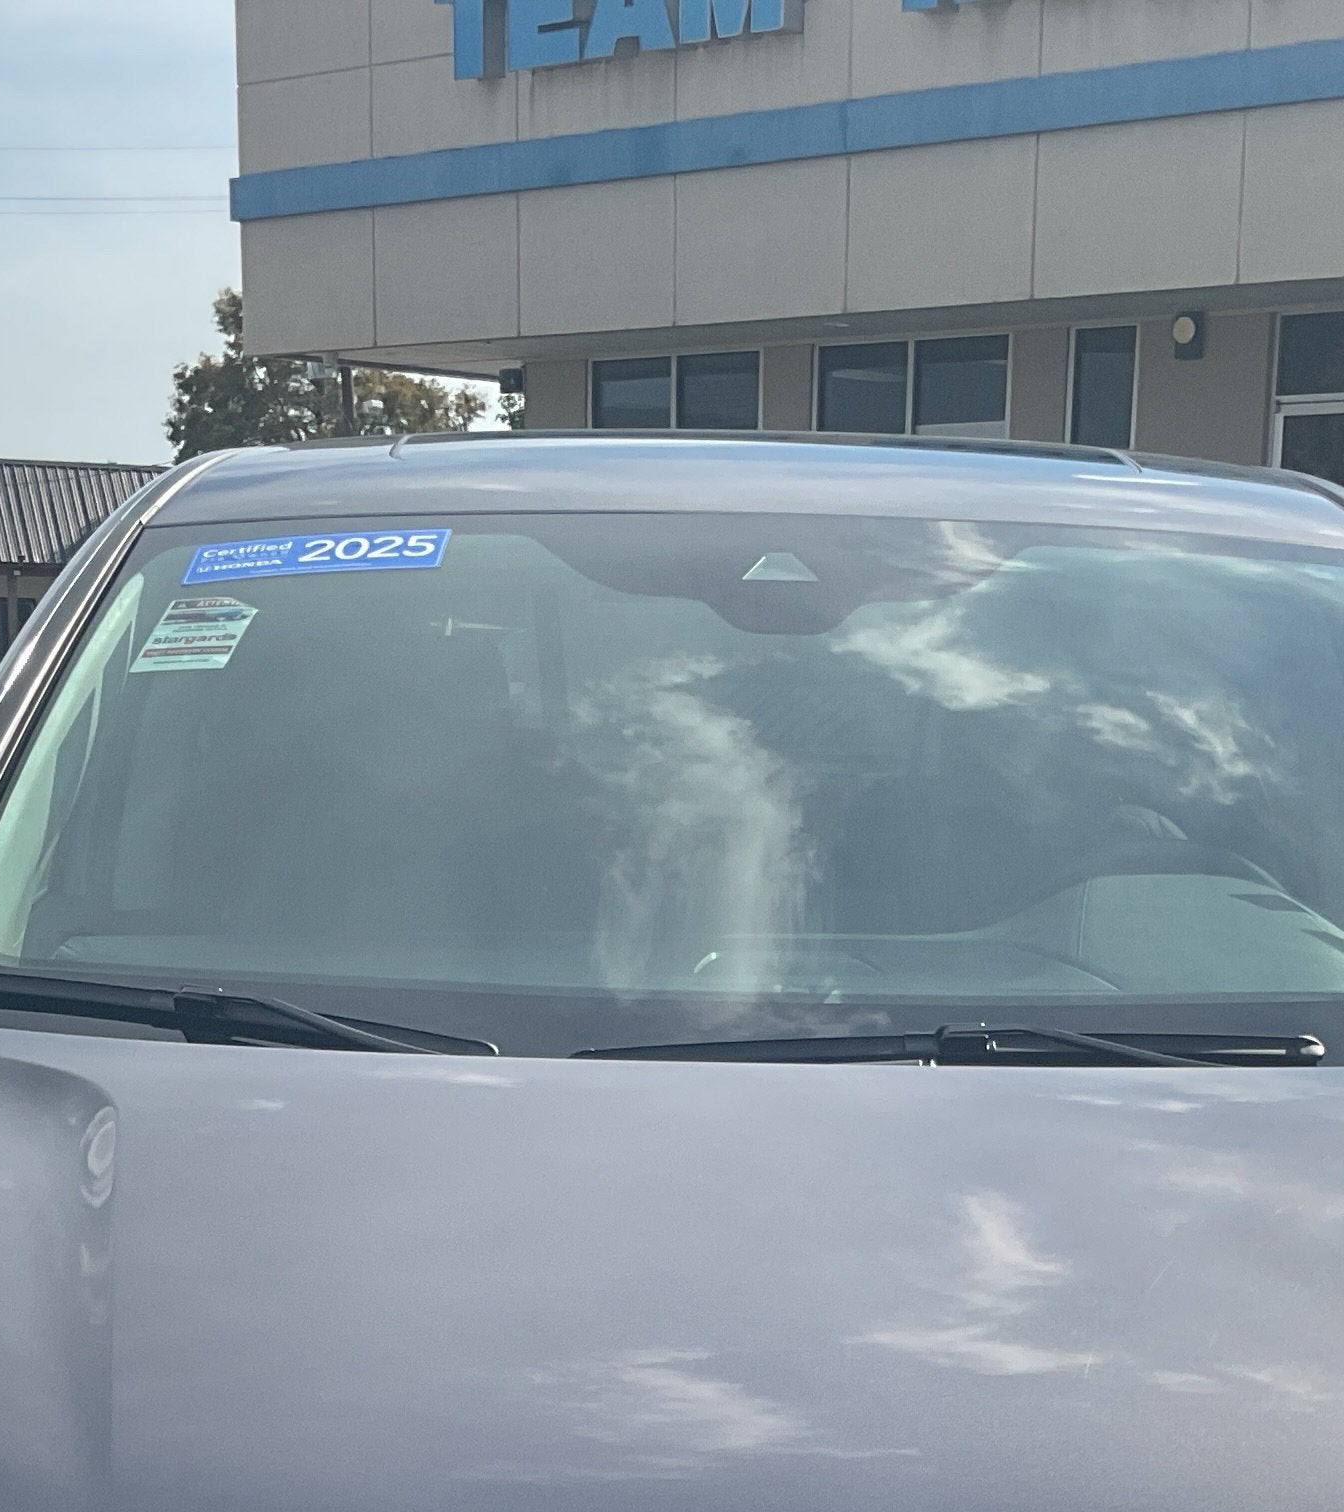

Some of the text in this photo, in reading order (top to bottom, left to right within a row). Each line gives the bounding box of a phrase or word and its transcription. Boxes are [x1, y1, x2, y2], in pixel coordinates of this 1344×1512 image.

[202, 541, 293, 558] Certified
[297, 535, 438, 562] 2025
[213, 559, 283, 571] HONDA
